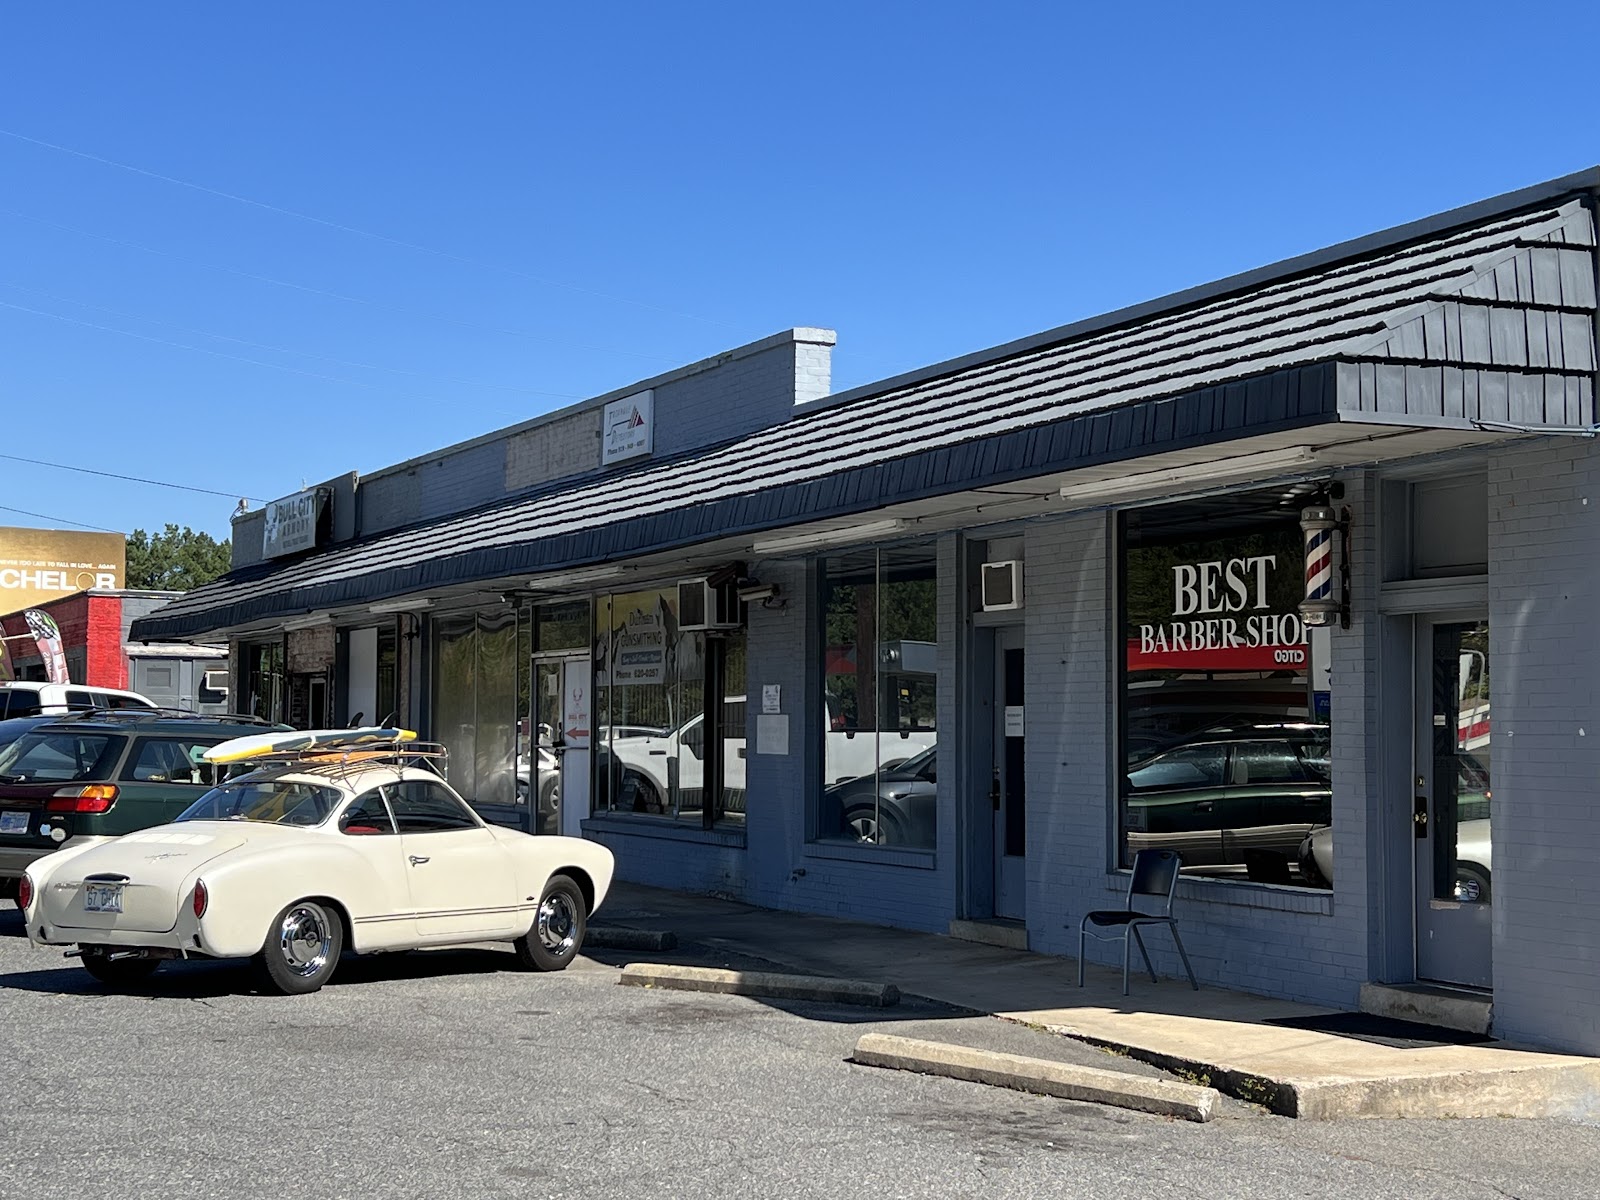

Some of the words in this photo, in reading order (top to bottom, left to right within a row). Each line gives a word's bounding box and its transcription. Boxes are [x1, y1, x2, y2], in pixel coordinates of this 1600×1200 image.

[279, 500, 297, 523] BULL
[298, 495, 315, 517] CITY
[0, 569, 116, 590] CHELOR
[1171, 555, 1276, 616] BEST
[620, 630, 662, 648] GUNSMITHING
[1139, 618, 1240, 654] BARBER
